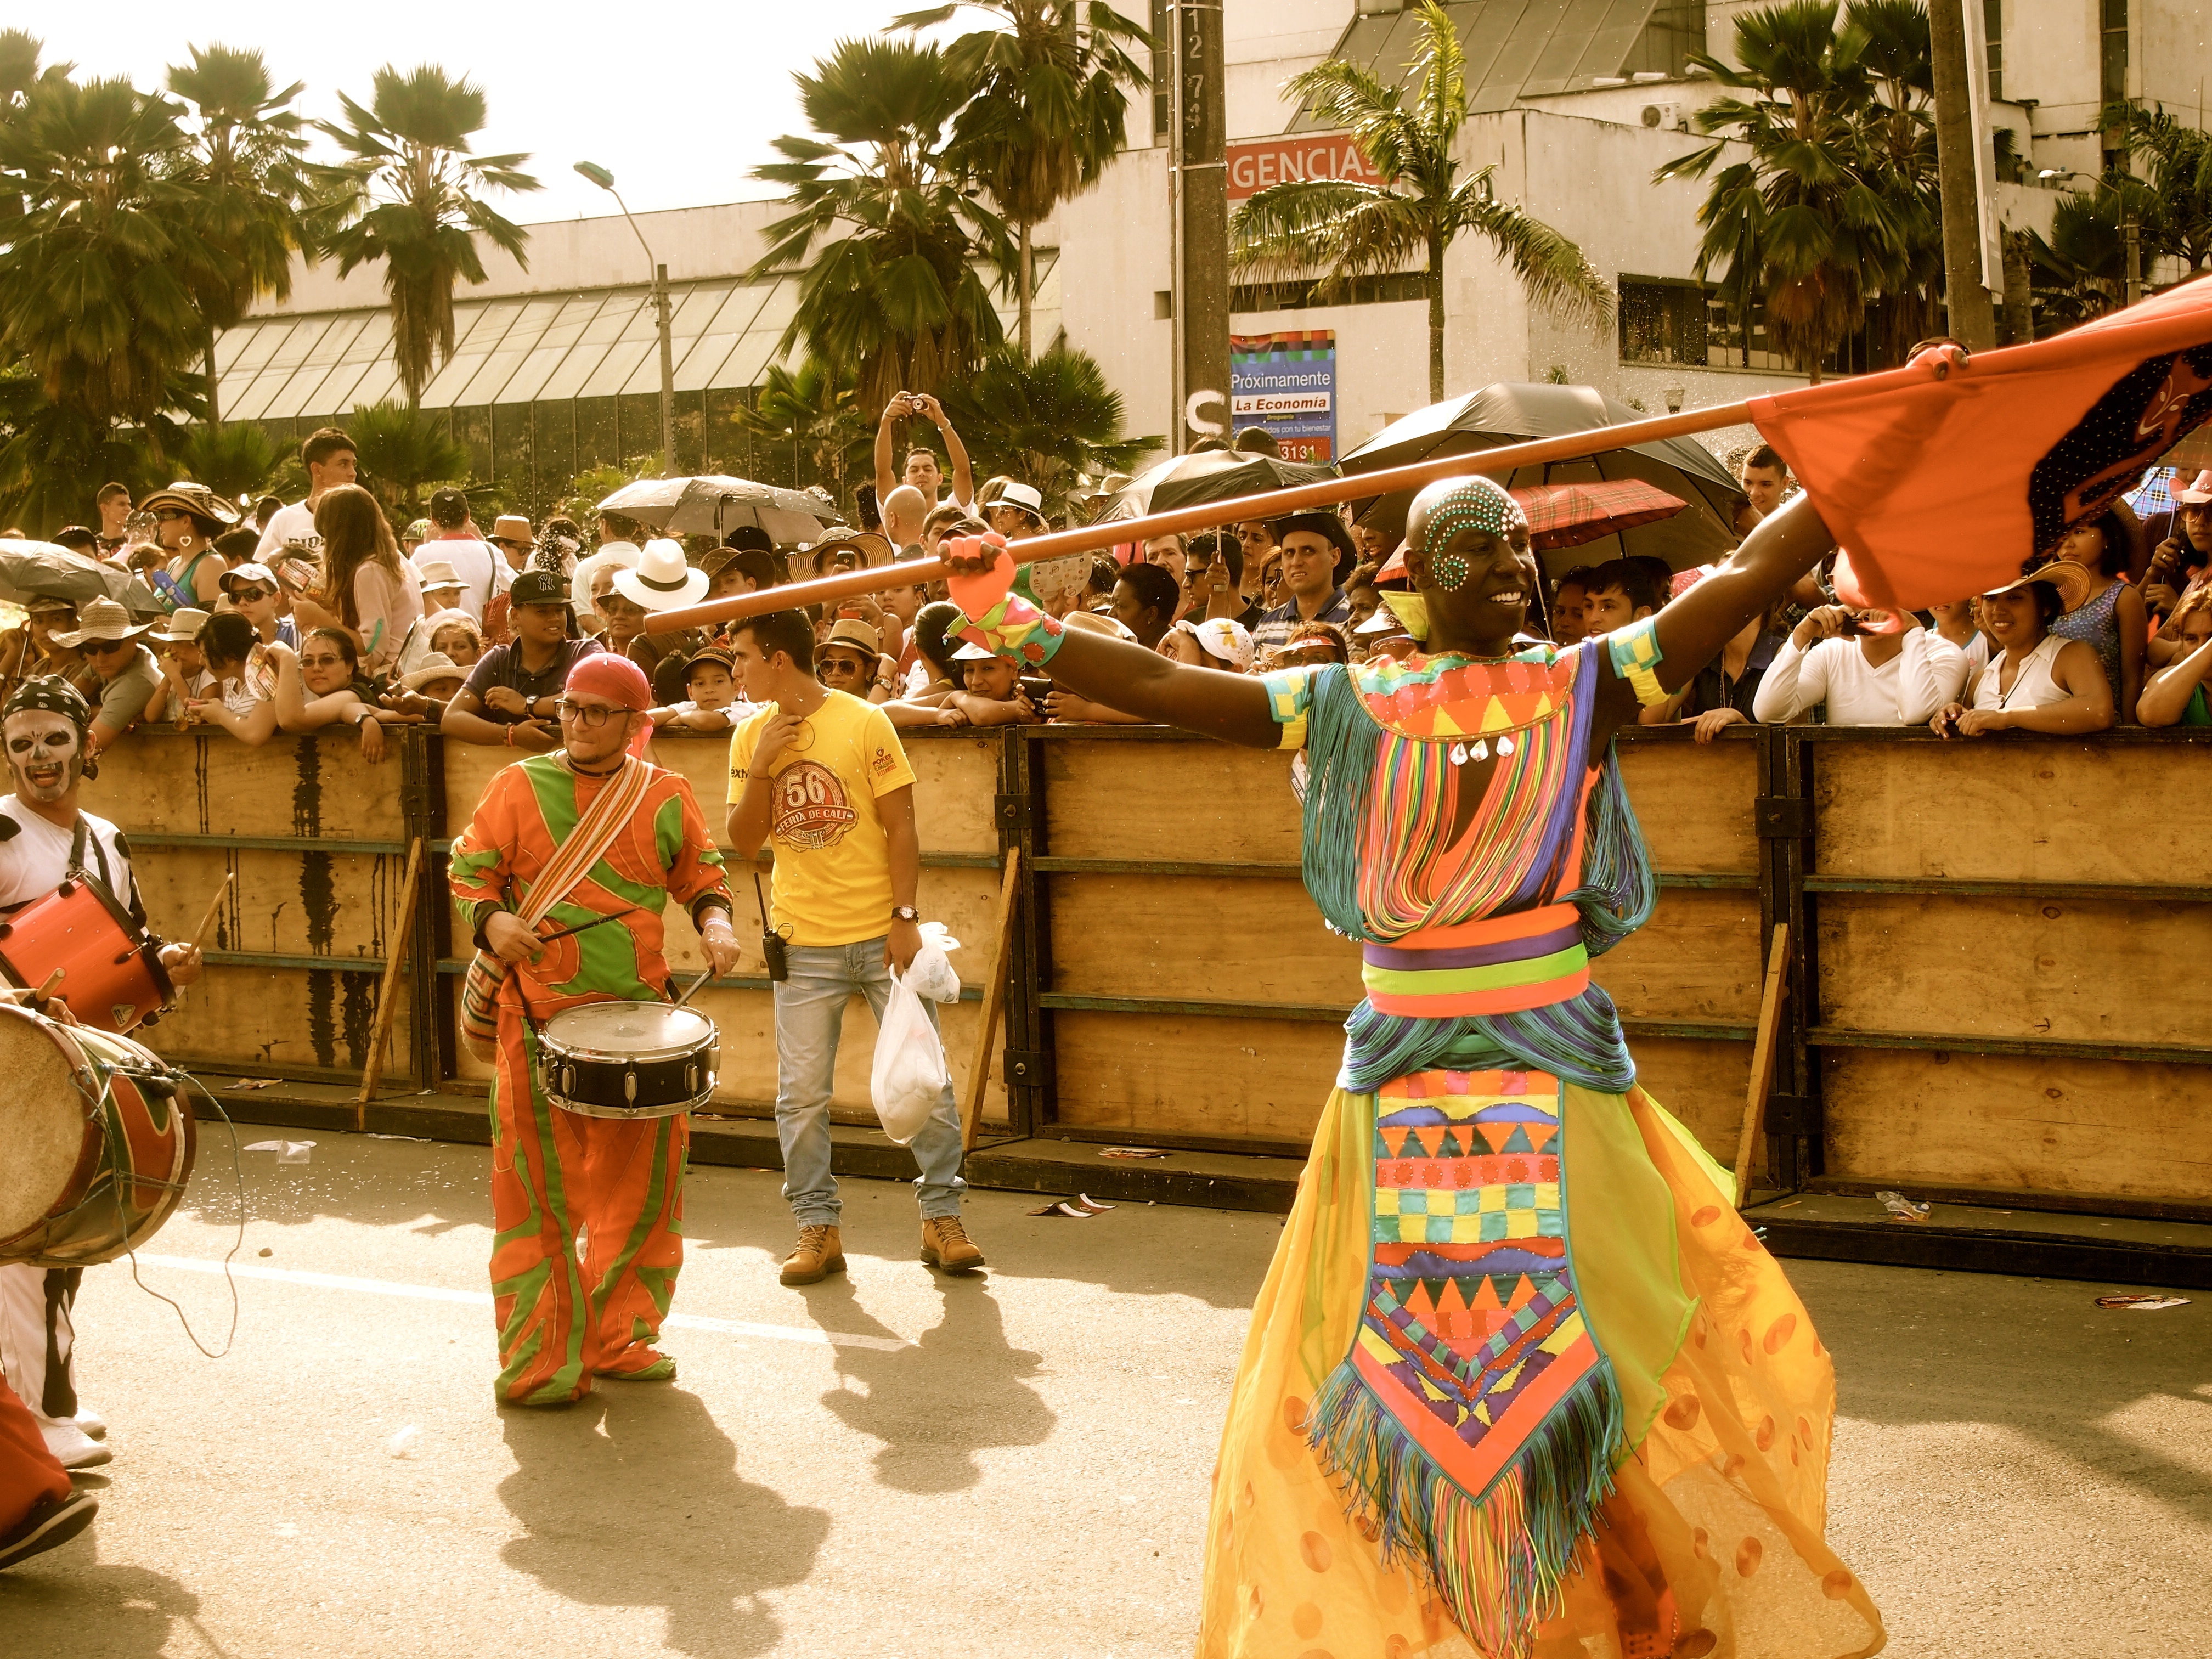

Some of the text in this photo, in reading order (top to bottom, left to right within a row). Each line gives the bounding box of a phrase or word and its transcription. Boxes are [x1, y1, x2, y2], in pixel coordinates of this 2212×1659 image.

[1227, 145, 1379, 189] GENCIA
[1232, 371, 1330, 389] Próximamente
[1235, 397, 1327, 411] La Economía
[872, 753, 892, 766] POKER
[786, 771, 825, 808] 56
[779, 809, 847, 831] FERIA DE CALI
